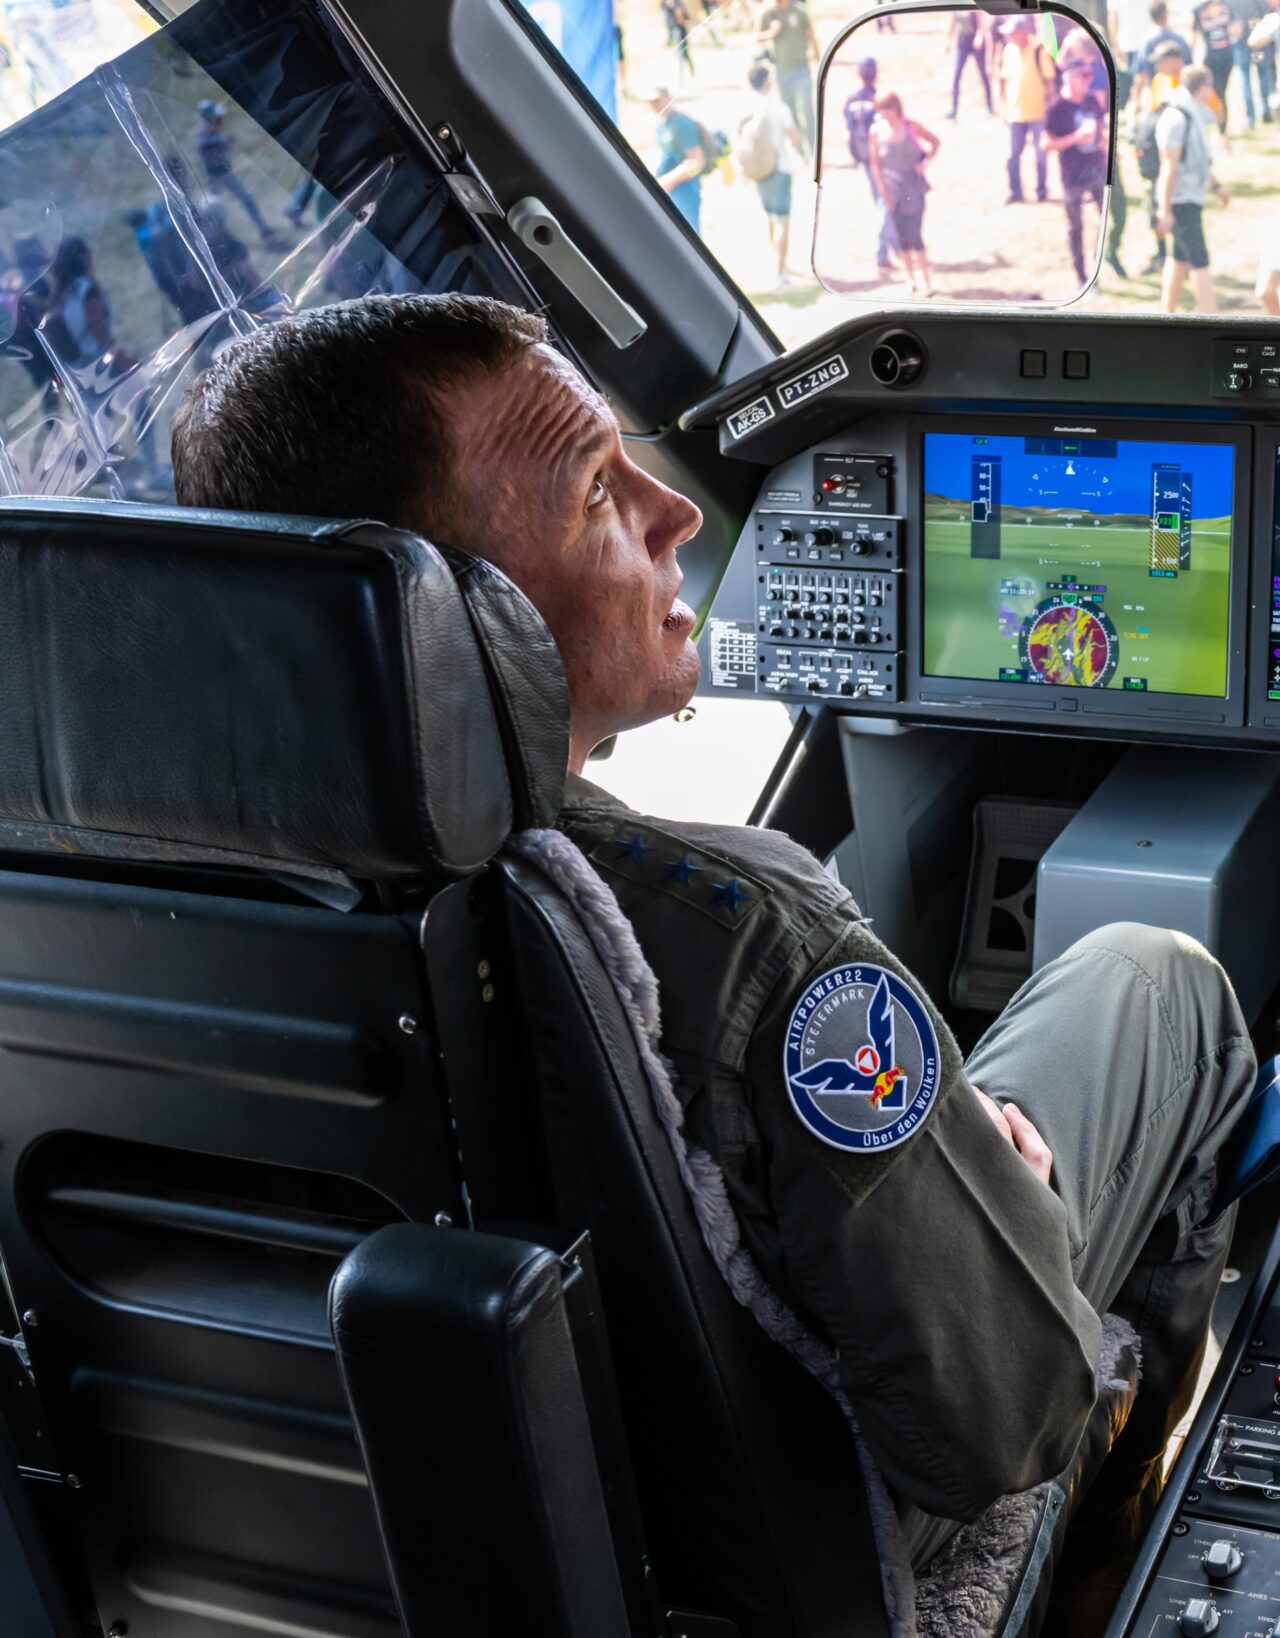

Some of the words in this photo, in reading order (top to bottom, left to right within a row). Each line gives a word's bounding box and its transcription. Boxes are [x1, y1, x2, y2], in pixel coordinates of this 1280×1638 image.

[783, 362, 841, 400] PT-ZNG
[736, 409, 767, 432] AK-GS
[788, 969, 863, 1051] AIRPOWER22
[805, 988, 865, 1056] STEIERMARK
[863, 1131, 894, 1147] Über
[897, 1112, 918, 1135] den
[914, 1057, 936, 1111] Wolken
[1245, 1425, 1276, 1435] PARKING
[1247, 1592, 1268, 1600] AHRS
